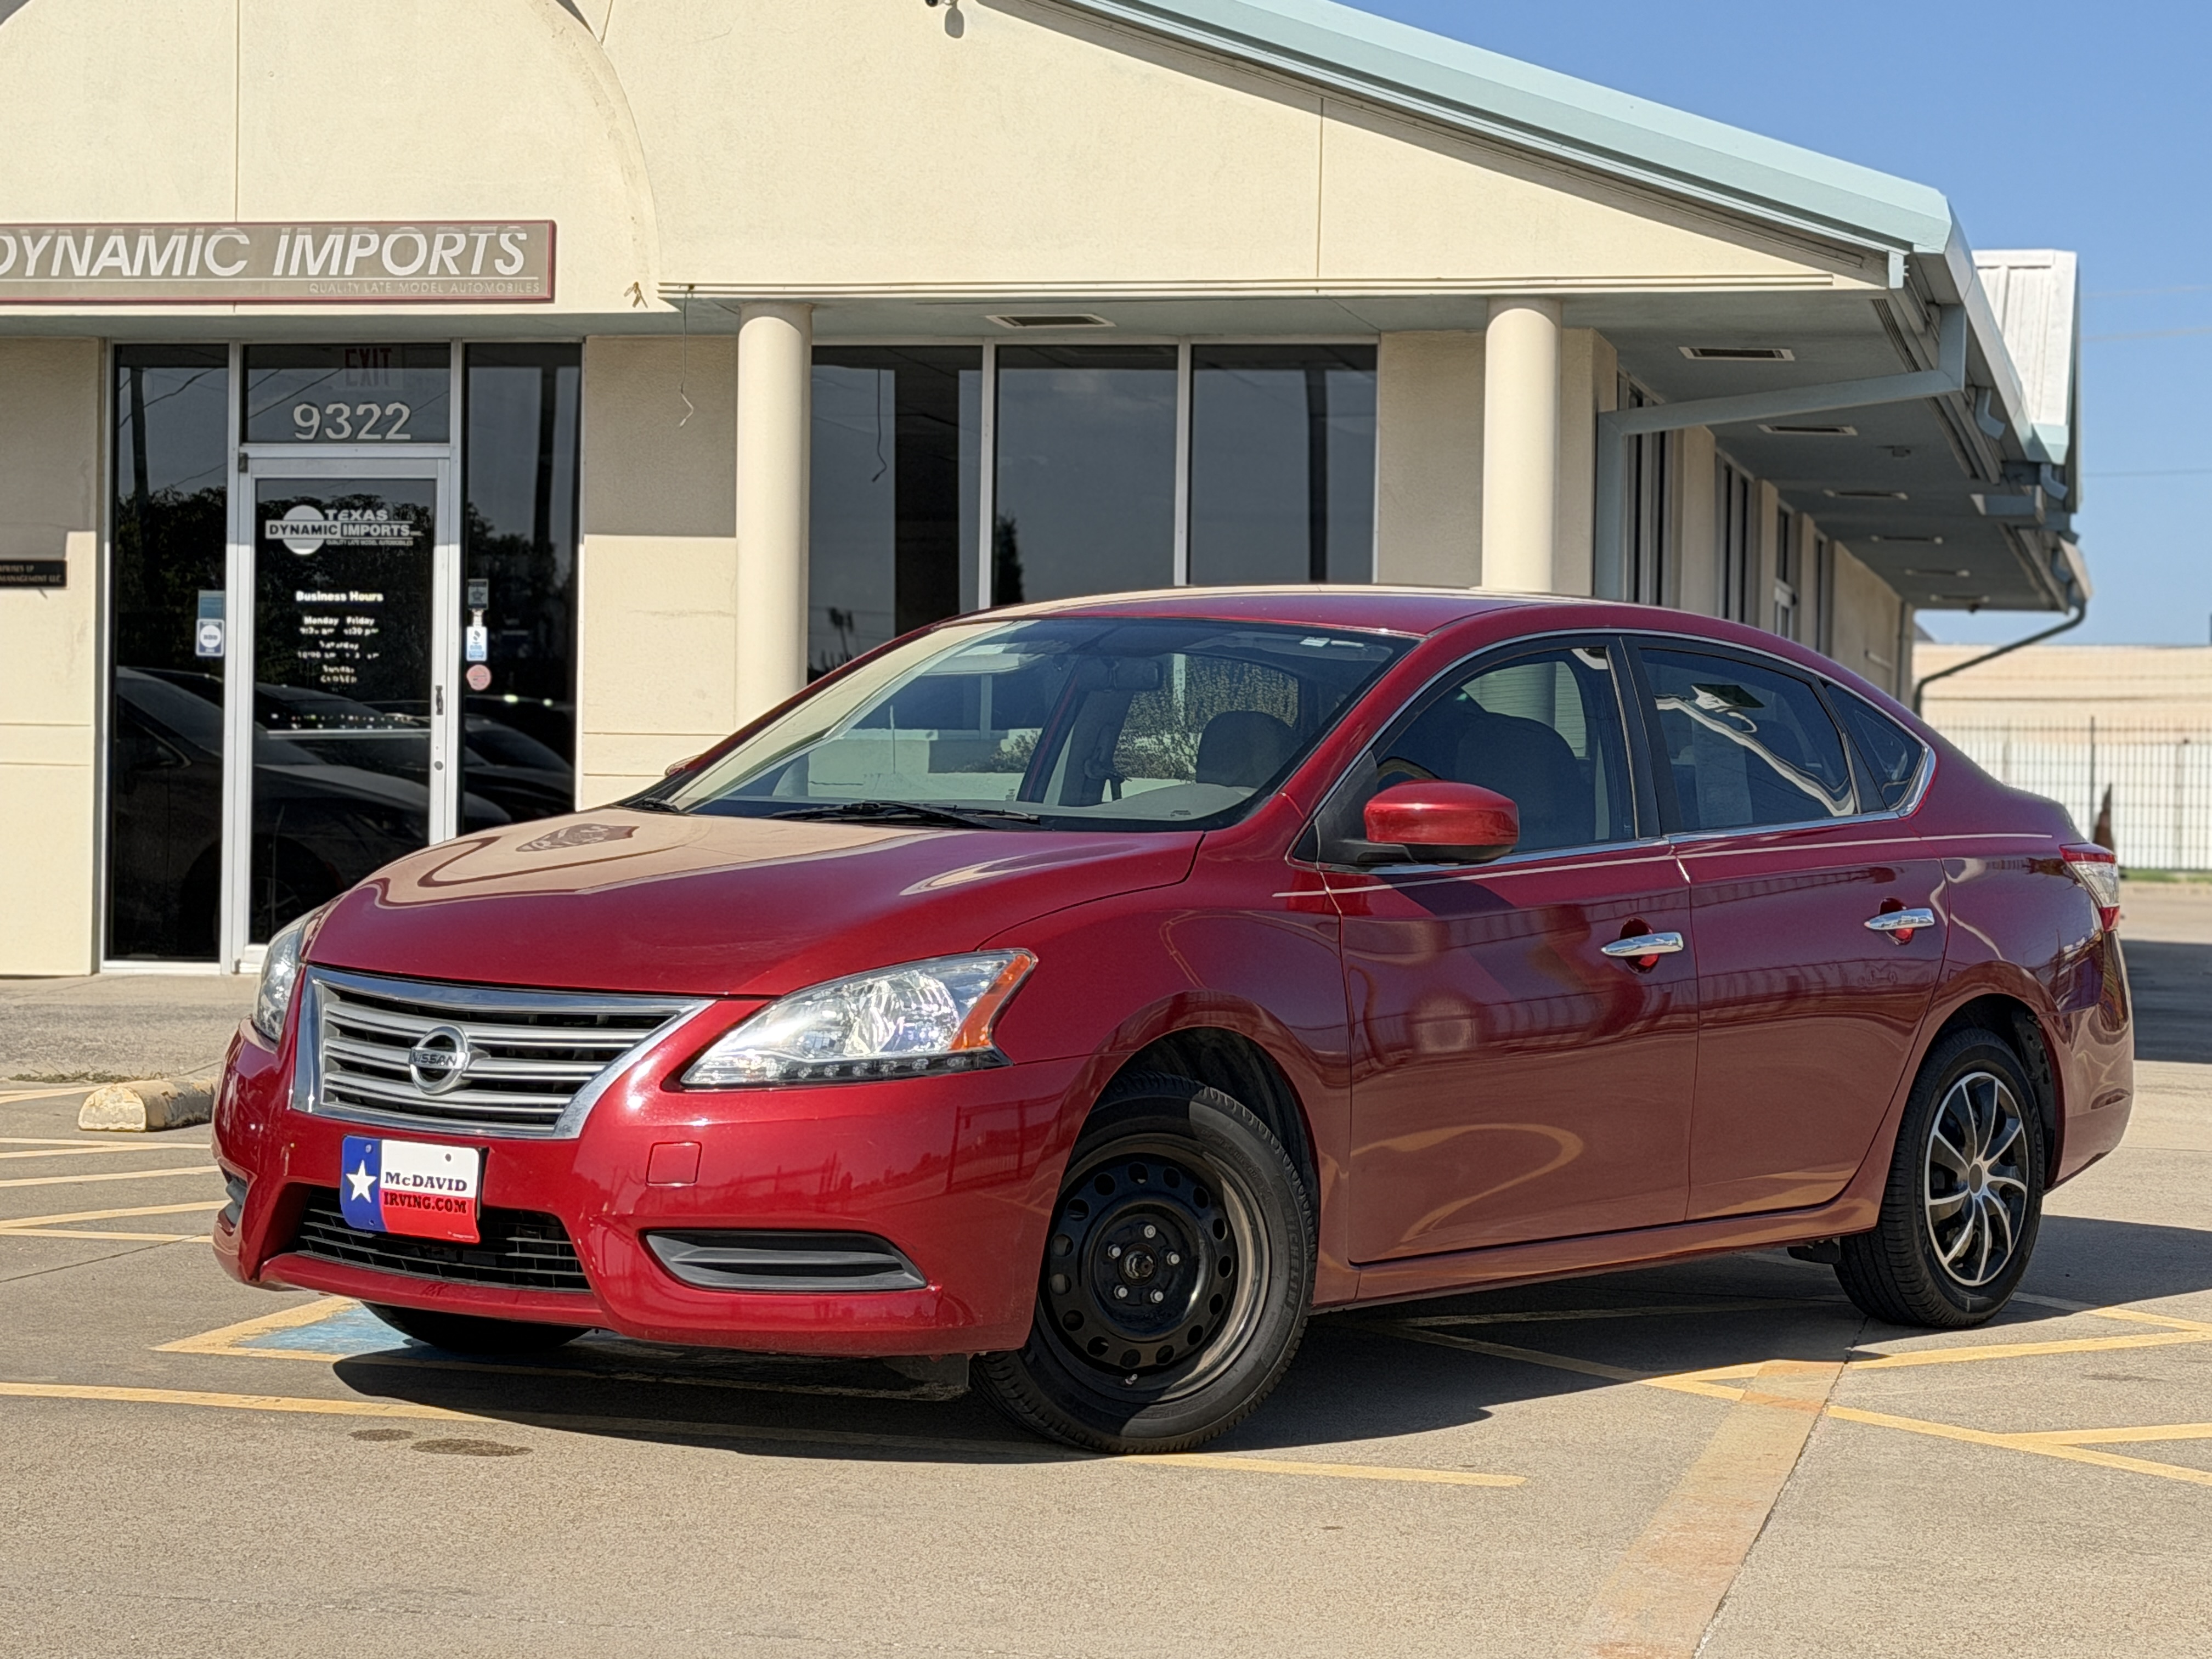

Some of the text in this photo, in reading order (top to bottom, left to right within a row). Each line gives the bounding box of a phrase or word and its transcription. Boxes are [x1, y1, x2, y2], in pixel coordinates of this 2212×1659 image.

[273, 226, 527, 276] IMPORTS
[309, 281, 540, 294] QUALITY LATE MODEL AUTOMOBILES
[345, 348, 392, 387] EXIT
[294, 402, 411, 439] 9322
[325, 509, 388, 521] TEXAS
[269, 524, 338, 535] DYNAMIC
[343, 524, 410, 536] IMPORTS
[296, 591, 383, 601] Business Hours
[304, 616, 375, 626] Monday Friday
[413, 1052, 458, 1066] NISSAN
[385, 1171, 467, 1192] McDAVID
[384, 1192, 466, 1214] IRVING.COM
